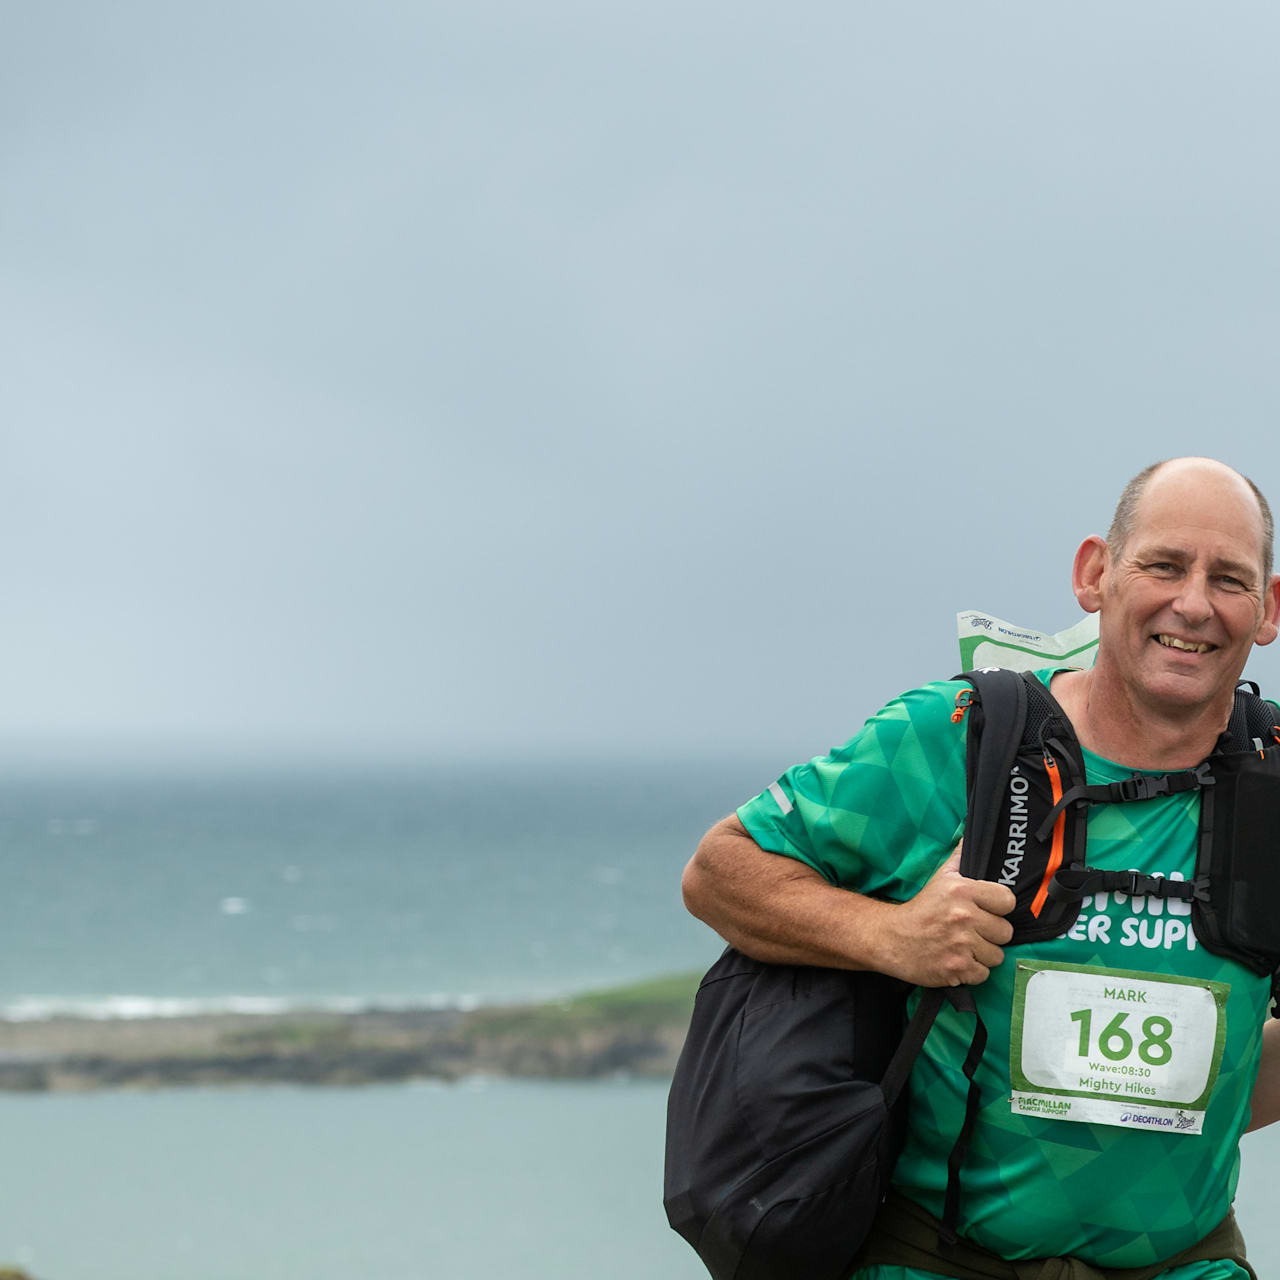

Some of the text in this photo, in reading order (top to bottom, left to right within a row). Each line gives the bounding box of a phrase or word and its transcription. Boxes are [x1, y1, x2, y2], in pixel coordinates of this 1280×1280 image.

[1103, 987, 1148, 1004] MARK
[1070, 1008, 1173, 1066] 168
[1088, 1062, 1152, 1078] Wave:08:30
[1079, 1076, 1157, 1096] Mighty Hikes
[1018, 1096, 1072, 1110] MACMILLAN
[1132, 1114, 1174, 1126] DECATHLON
